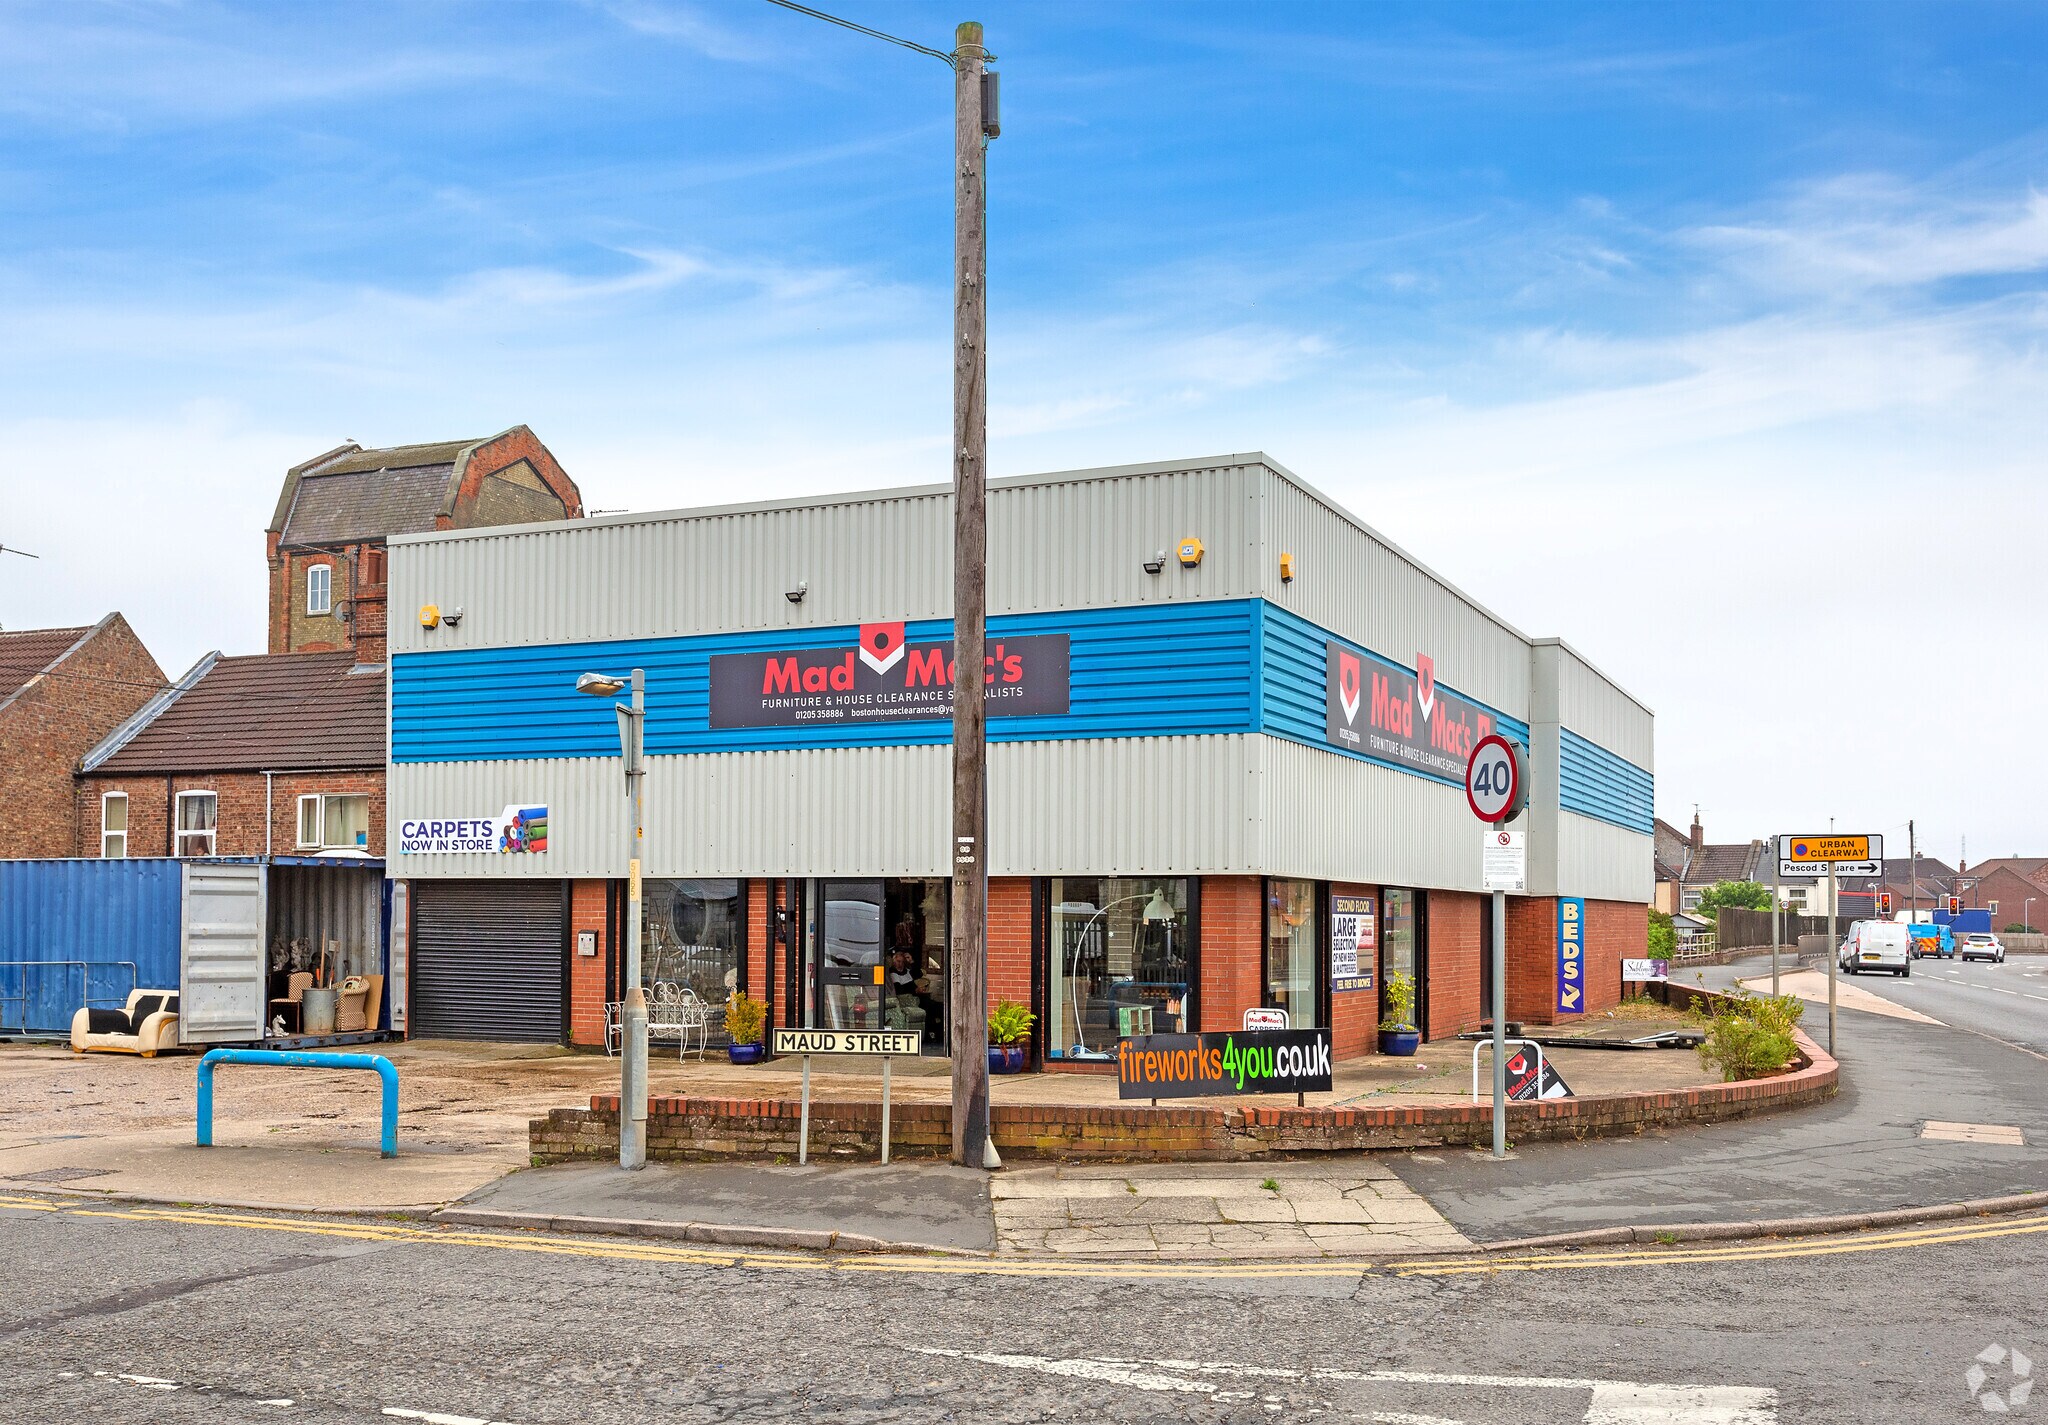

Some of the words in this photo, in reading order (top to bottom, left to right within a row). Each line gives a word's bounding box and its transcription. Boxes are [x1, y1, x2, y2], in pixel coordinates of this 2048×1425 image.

[762, 652, 854, 694] Mad
[762, 696, 821, 708] FURNITURE
[825, 697, 832, 706] &
[836, 695, 872, 705] HOUSE
[876, 691, 943, 703] CLEARANCE
[948, 687, 1023, 700] SALISTS
[795, 710, 816, 719] 01205
[817, 709, 844, 718] 358886
[1371, 671, 1412, 739] Mad
[1431, 698, 1471, 760] Mac's
[1370, 734, 1399, 756] FURNITURE
[1400, 743, 1404, 757] &
[1404, 744, 1420, 762] HOUSE
[1420, 751, 1446, 770] CLEARANCE
[1474, 760, 1510, 796] 40
[402, 820, 493, 838] CARPETS
[401, 840, 432, 851] NOW
[436, 840, 448, 850] IN
[451, 839, 493, 850] STORE
[1810, 848, 1865, 857] CLEARWAY
[1820, 840, 1855, 848] URBAN
[1784, 863, 1817, 872] Pescod
[1821, 864, 1855, 872] Suare
[1336, 899, 1355, 912] SECOND
[1355, 900, 1370, 913] FLOOR
[1333, 917, 1356, 937] LARGE
[1333, 938, 1356, 951] SELECTION
[1563, 903, 1580, 980] BEDS
[1333, 953, 1338, 963] OF
[1338, 952, 1347, 962] NEW
[1347, 952, 1356, 962] BEDS
[781, 1033, 836, 1051] MAUD
[844, 1035, 915, 1052] STREET
[1118, 1033, 1331, 1090] fireworks4you.co.uk
[1508, 1074, 1528, 1096] Mad
